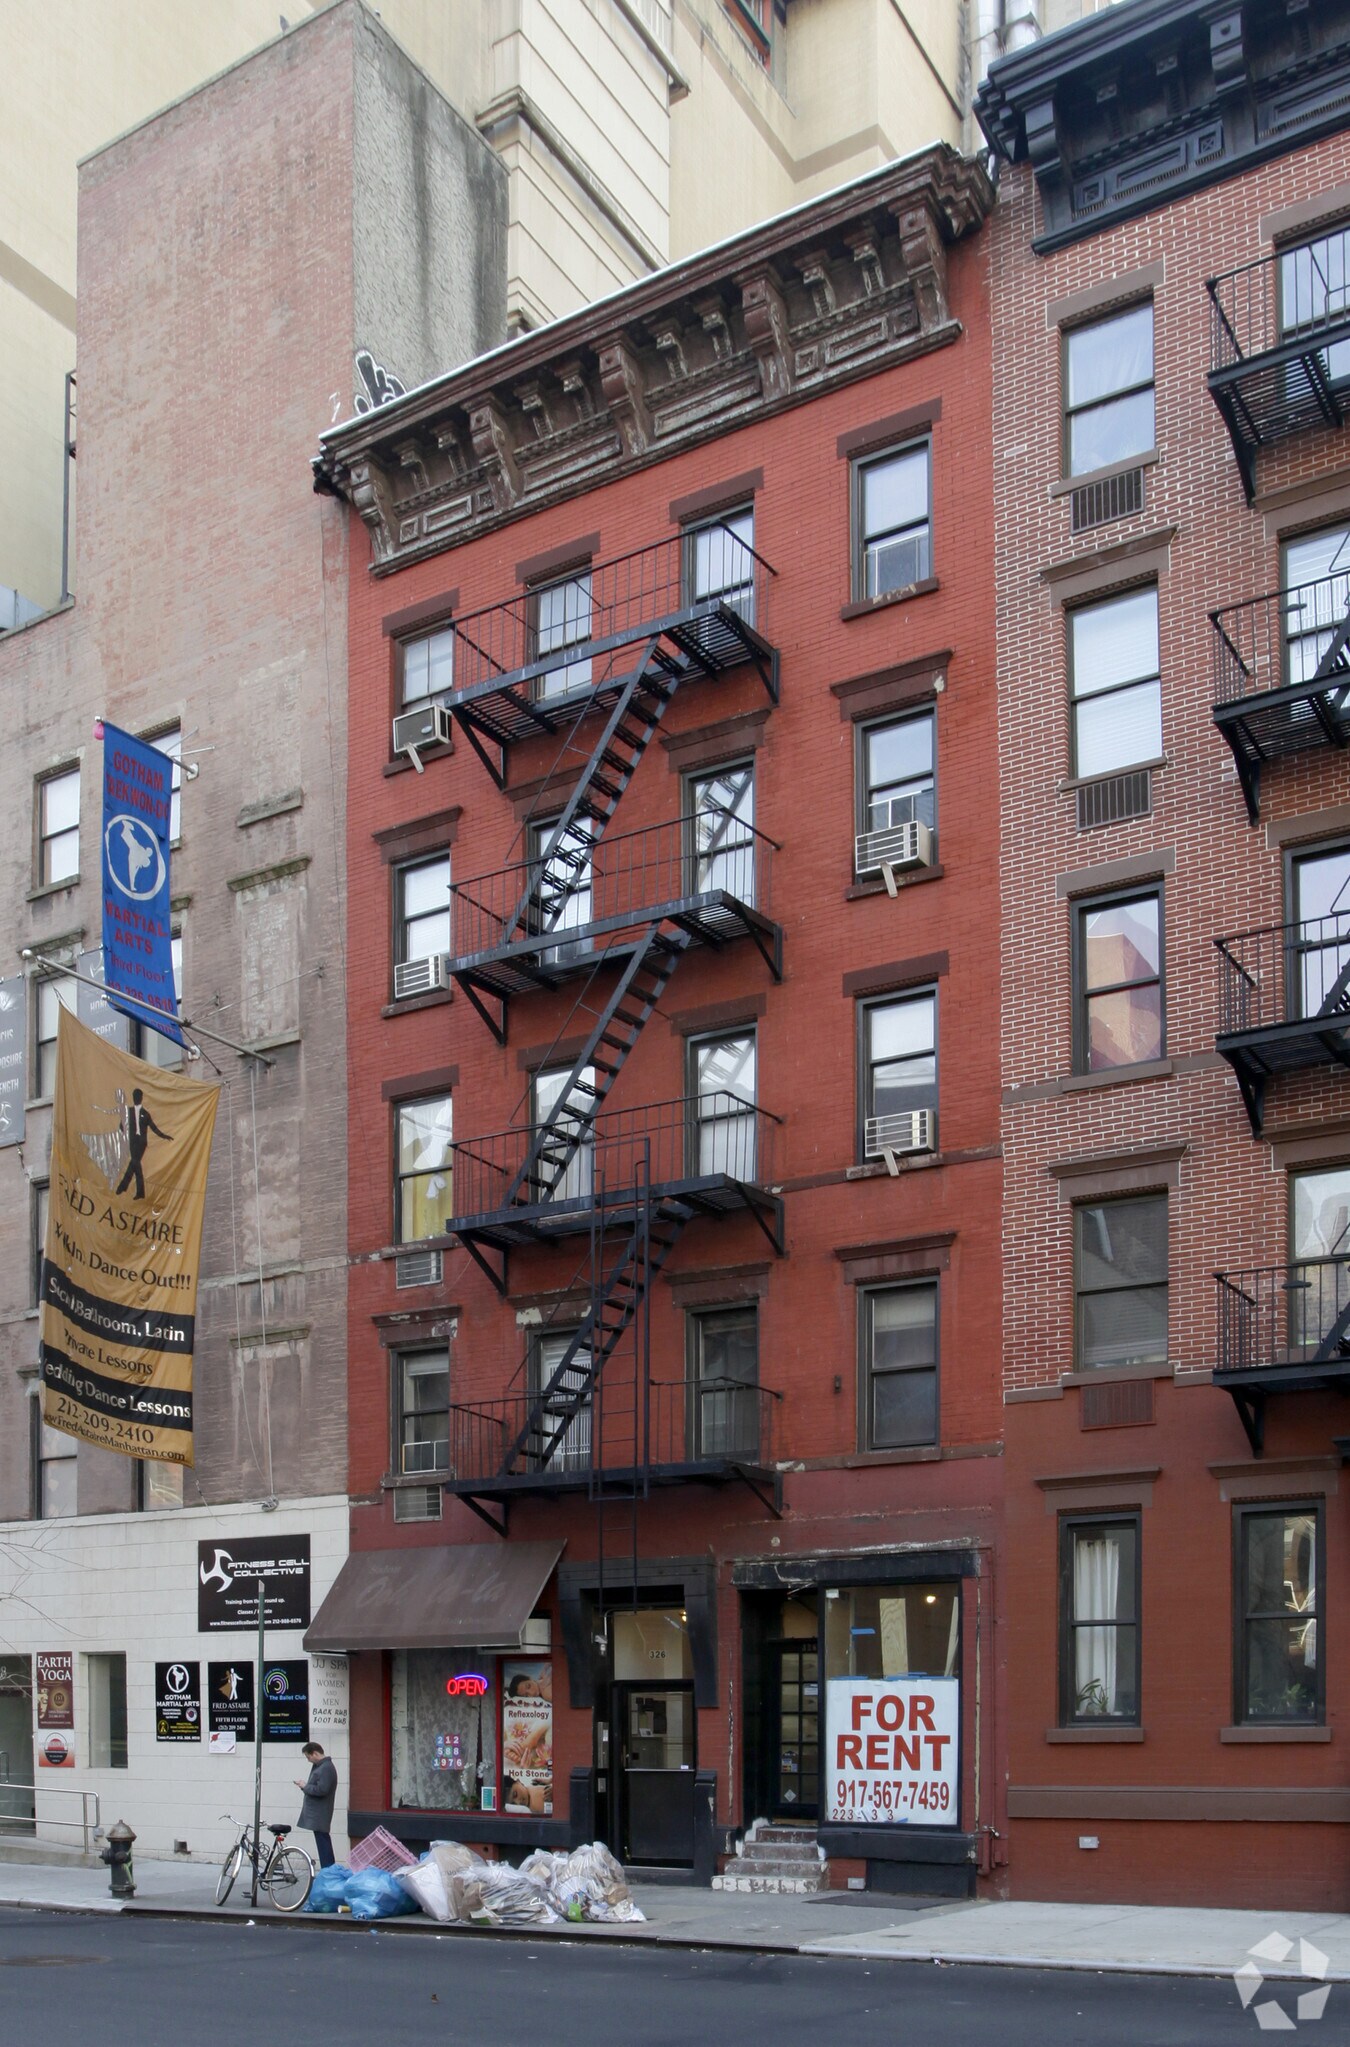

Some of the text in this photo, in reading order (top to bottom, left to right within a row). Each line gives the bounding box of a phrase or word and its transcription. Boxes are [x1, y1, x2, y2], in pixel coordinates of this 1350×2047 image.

[113, 751, 163, 792] GOTHAM
[115, 928, 153, 955] ARTS
[136, 963, 165, 983] Floor
[99, 1206, 184, 1244] ASTAIRE
[90, 1251, 138, 1282] Dance
[141, 1269, 191, 1290] Out!!!
[145, 1321, 185, 1342] Latin
[98, 1347, 153, 1375] Lessons
[85, 1381, 126, 1409] Dance
[129, 1395, 191, 1418] Lessons
[227, 1558, 310, 1569] FITNESS CELL
[233, 1567, 304, 1577] COLLECTIVE
[37, 1655, 71, 1668] EARTH
[650, 1651, 666, 1659] 326
[330, 1659, 348, 1670] SPA
[41, 1669, 71, 1681] YOGA
[316, 1679, 345, 1688] WOMEN
[447, 1679, 485, 1696] OPEN
[323, 1698, 339, 1706] MEN
[508, 1710, 549, 1720] Reflexology
[851, 1694, 936, 1731] FOR
[836, 1734, 951, 1771] RENT
[508, 1769, 549, 1778] Hot Stone
[837, 1779, 950, 1811] 917-567-7459
